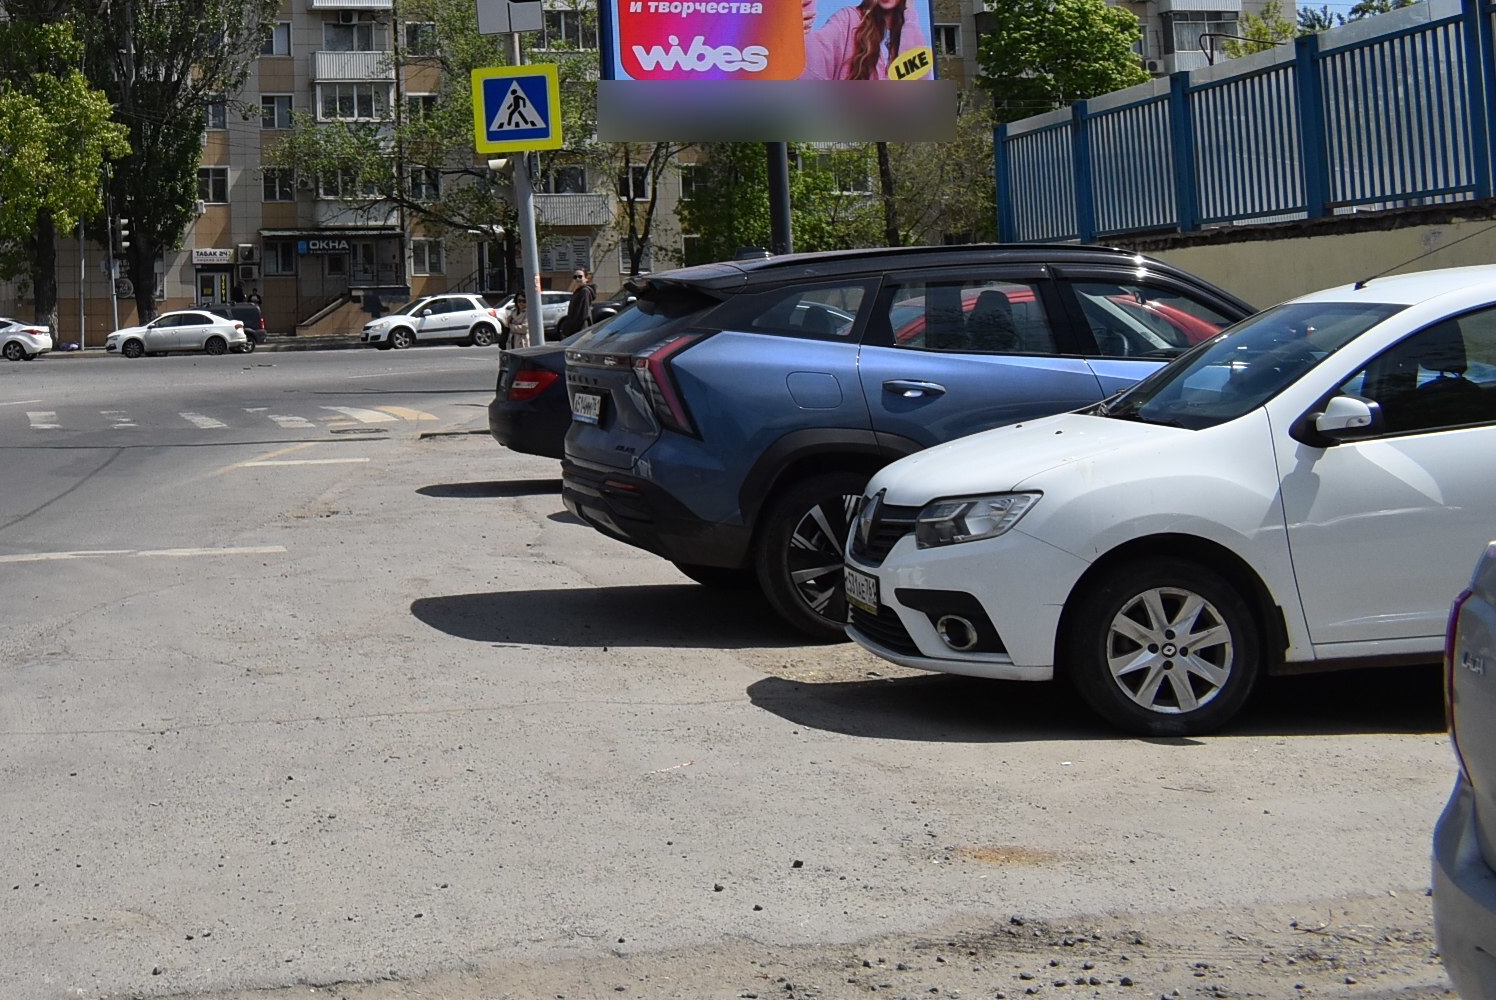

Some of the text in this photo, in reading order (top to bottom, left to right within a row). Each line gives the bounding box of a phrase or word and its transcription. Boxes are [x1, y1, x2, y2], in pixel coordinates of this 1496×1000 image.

[629, 2, 763, 18] и творчества
[632, 35, 769, 72] wibes
[894, 51, 929, 80] LIKE
[309, 240, 349, 249] ОКНА
